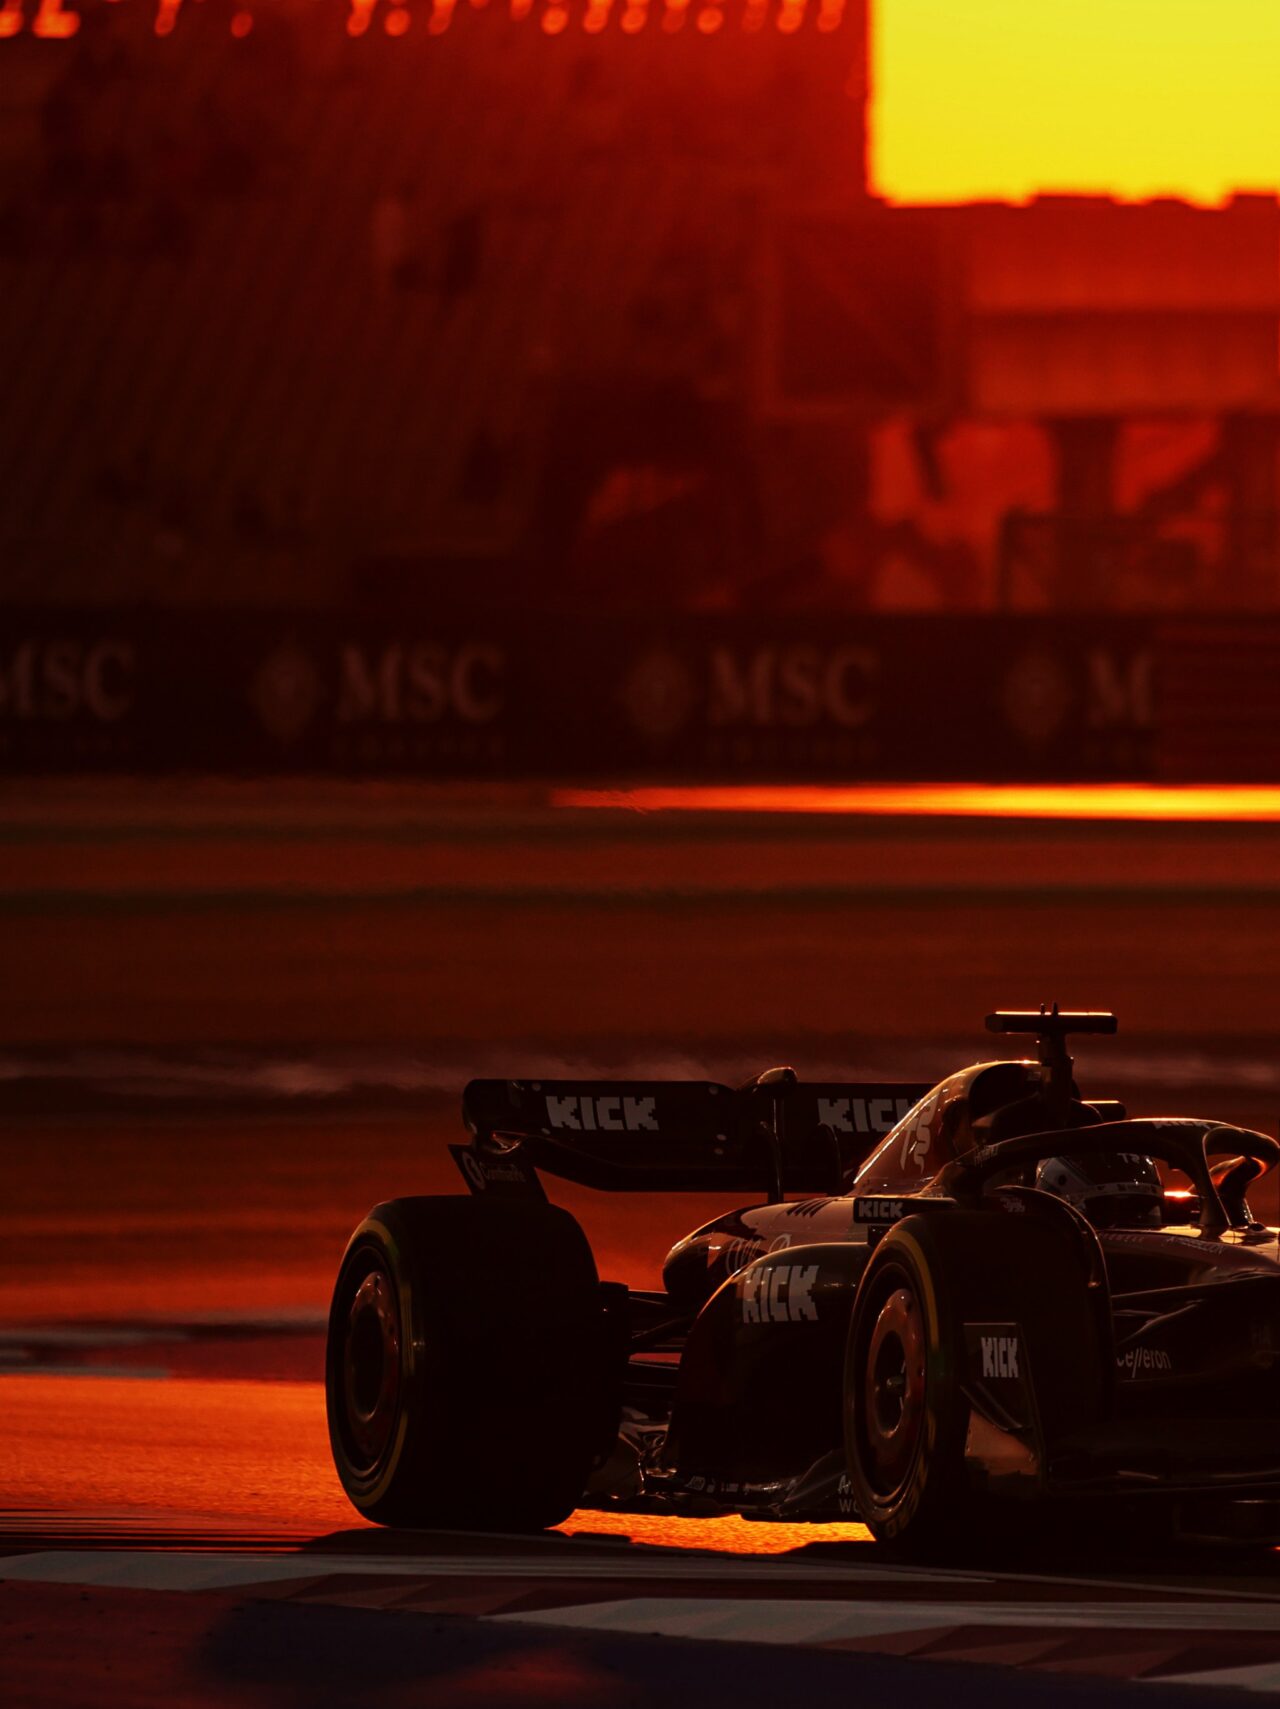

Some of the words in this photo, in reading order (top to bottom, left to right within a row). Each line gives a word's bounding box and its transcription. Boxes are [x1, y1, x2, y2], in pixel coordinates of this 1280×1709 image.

[337, 641, 505, 722] MSC
[710, 644, 881, 726] MSC
[545, 1096, 660, 1131] KICK
[858, 1201, 903, 1219] KICK
[742, 1265, 820, 1324] KICK
[980, 1337, 1019, 1378] KICK
